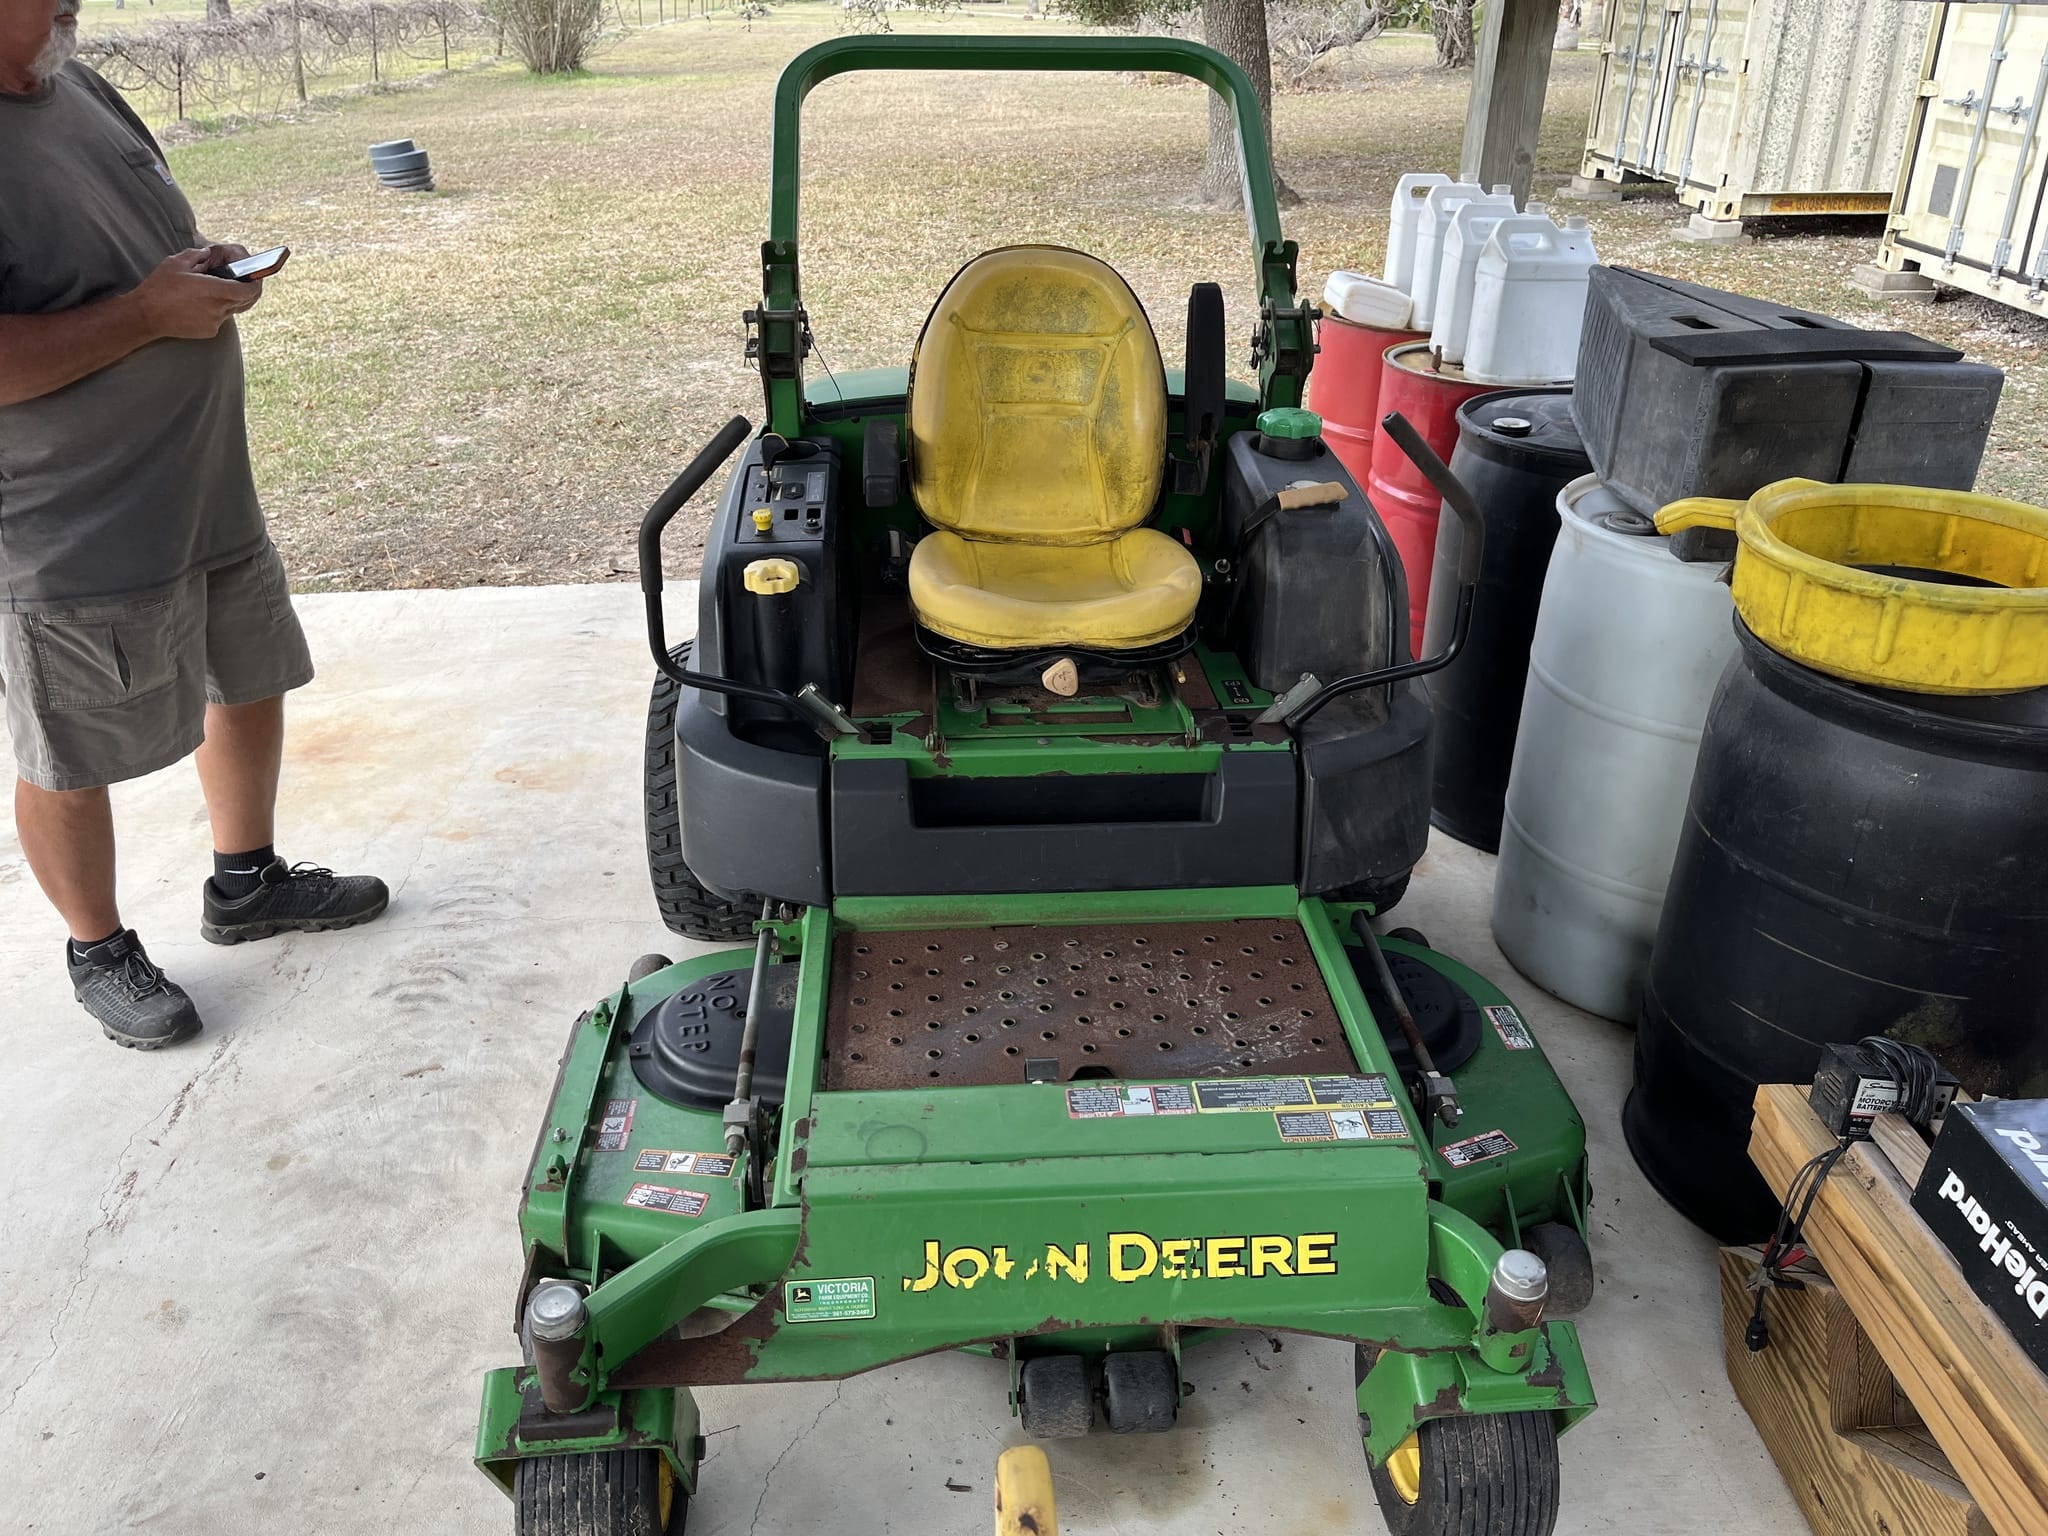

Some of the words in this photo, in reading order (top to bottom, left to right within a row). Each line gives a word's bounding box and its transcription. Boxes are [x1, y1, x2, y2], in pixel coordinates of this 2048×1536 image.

[706, 975, 737, 1011] NO
[679, 992, 710, 1053] STEP
[1856, 1103, 1888, 1112] BATTERY
[2006, 1220, 2036, 1253] AHEAD
[1107, 1231, 1339, 1284] DEERE
[817, 1282, 869, 1294] VICTORIA
